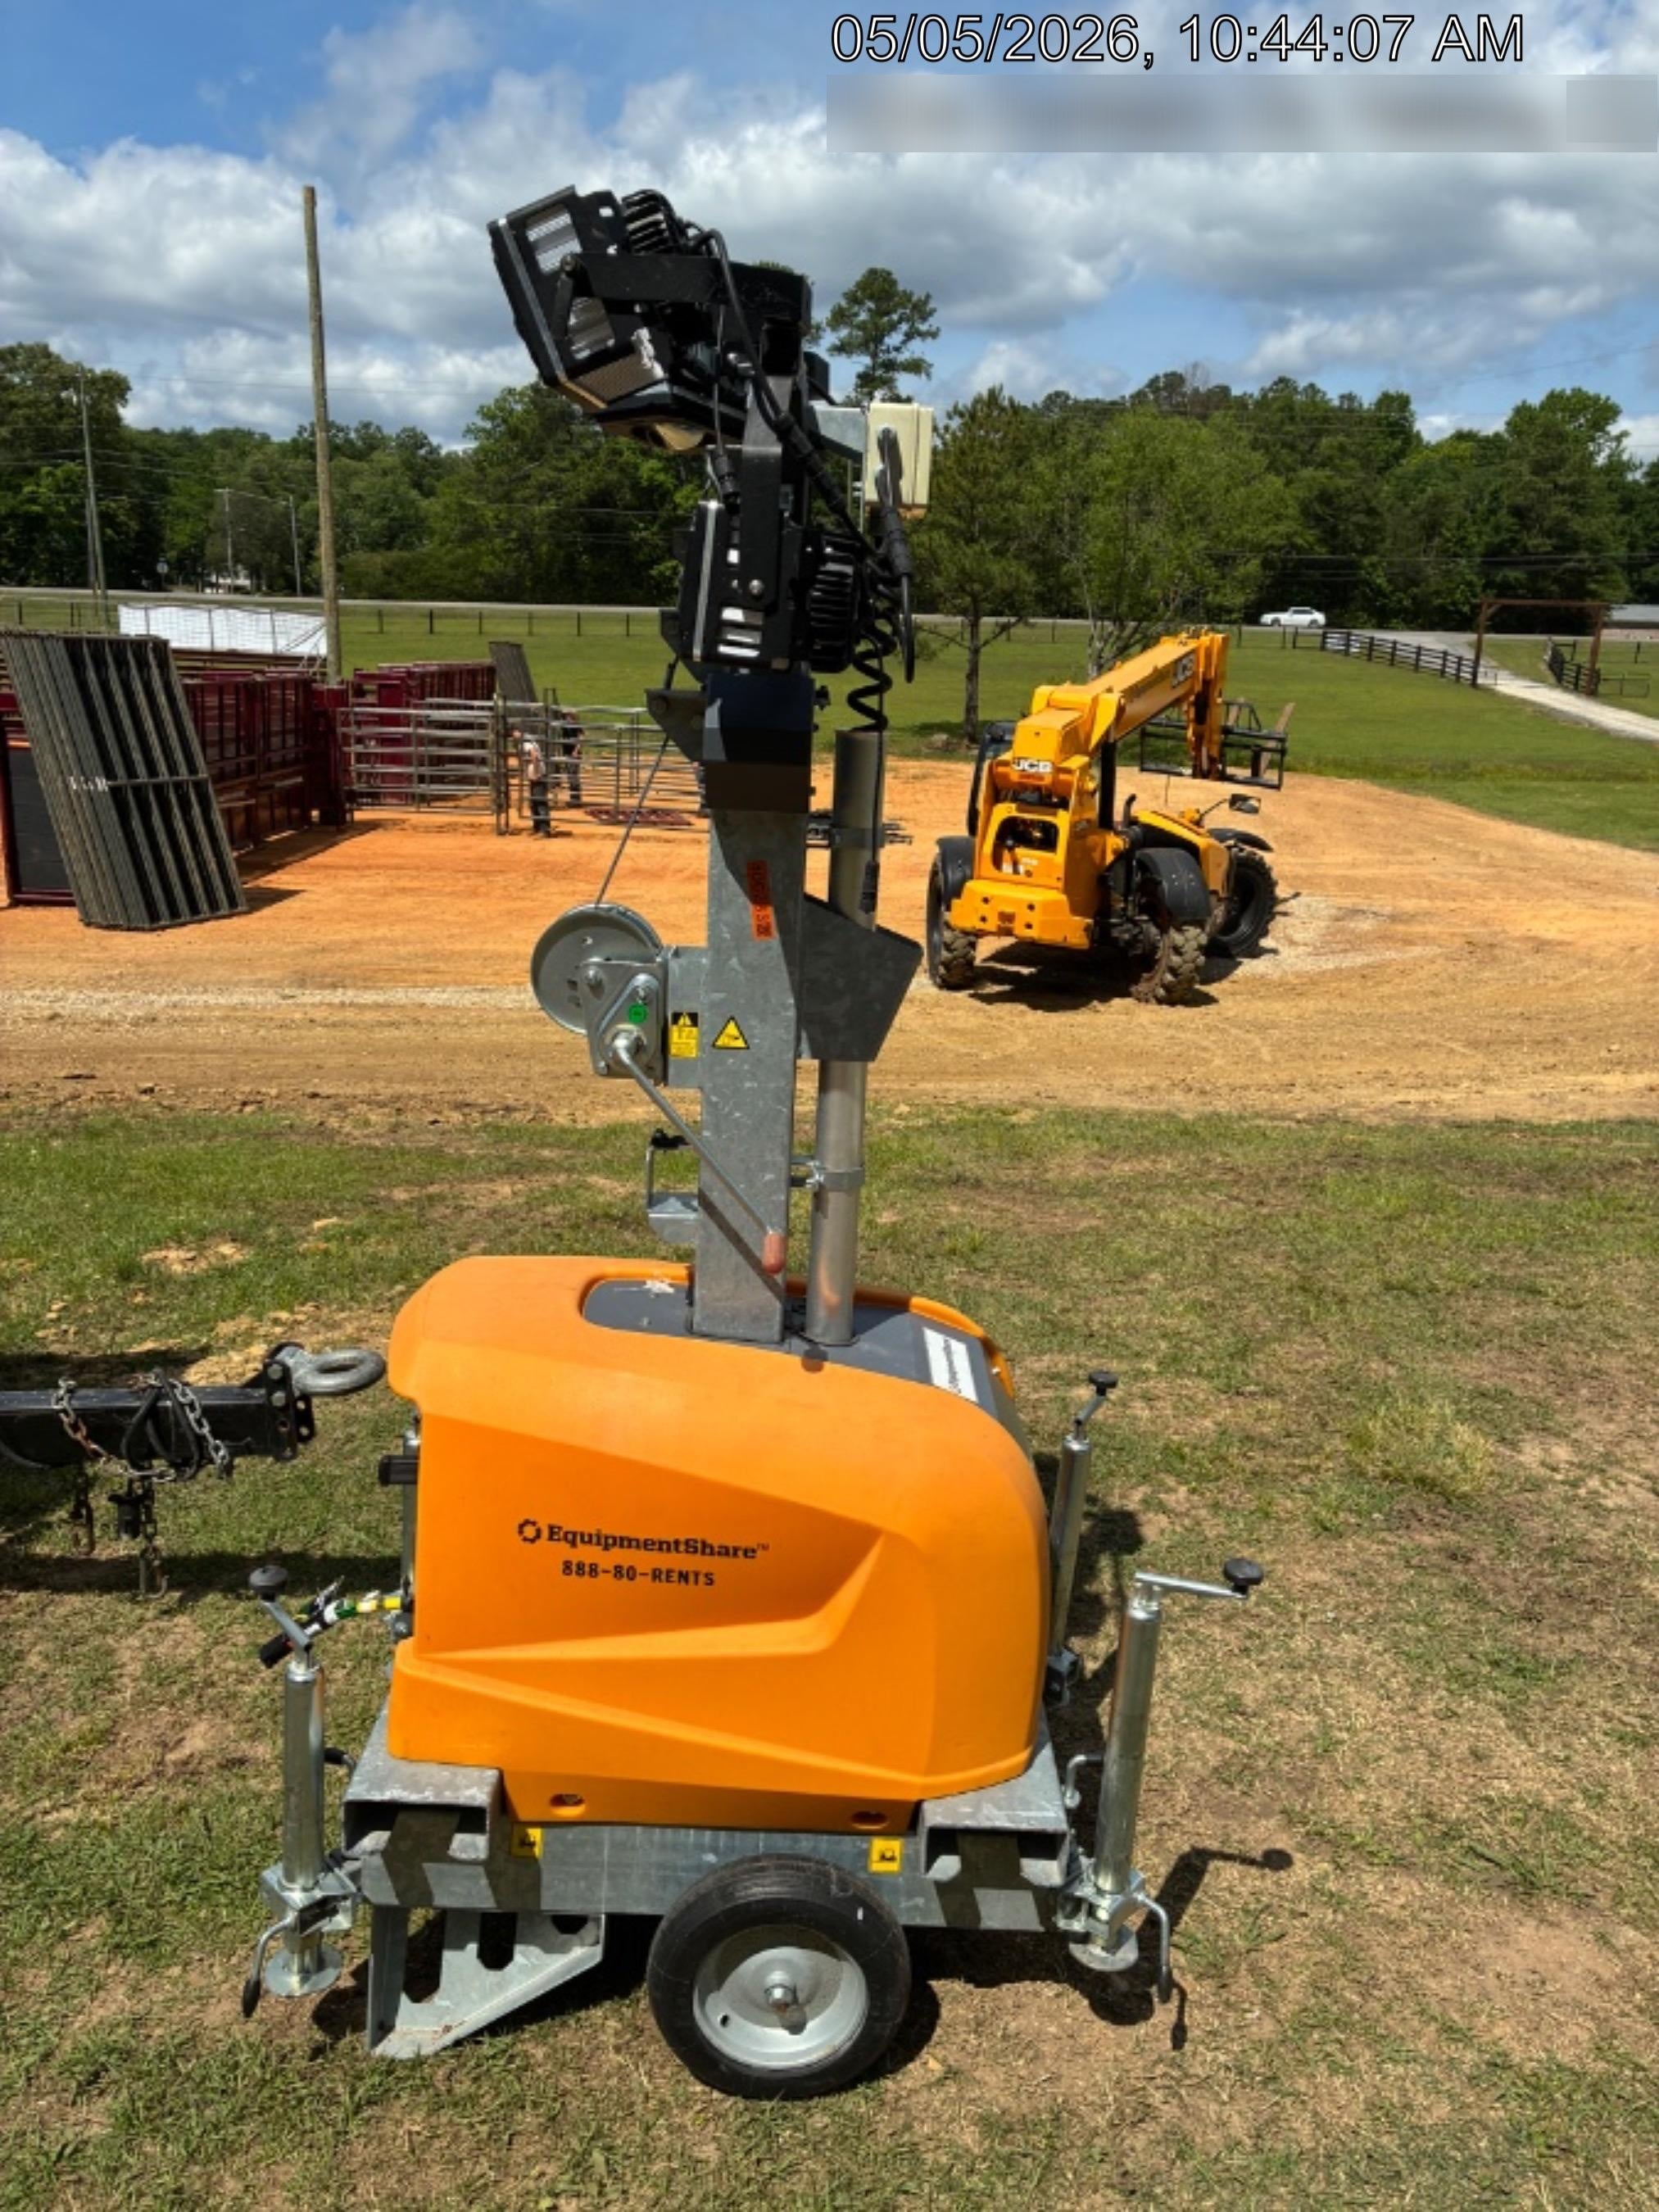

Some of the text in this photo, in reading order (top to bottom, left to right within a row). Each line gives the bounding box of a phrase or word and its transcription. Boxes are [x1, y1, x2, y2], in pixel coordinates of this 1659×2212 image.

[1171, 653, 1194, 688] JCB
[1011, 759, 1053, 773] JCB
[562, 1559, 715, 1587] 888-80-RENTS
